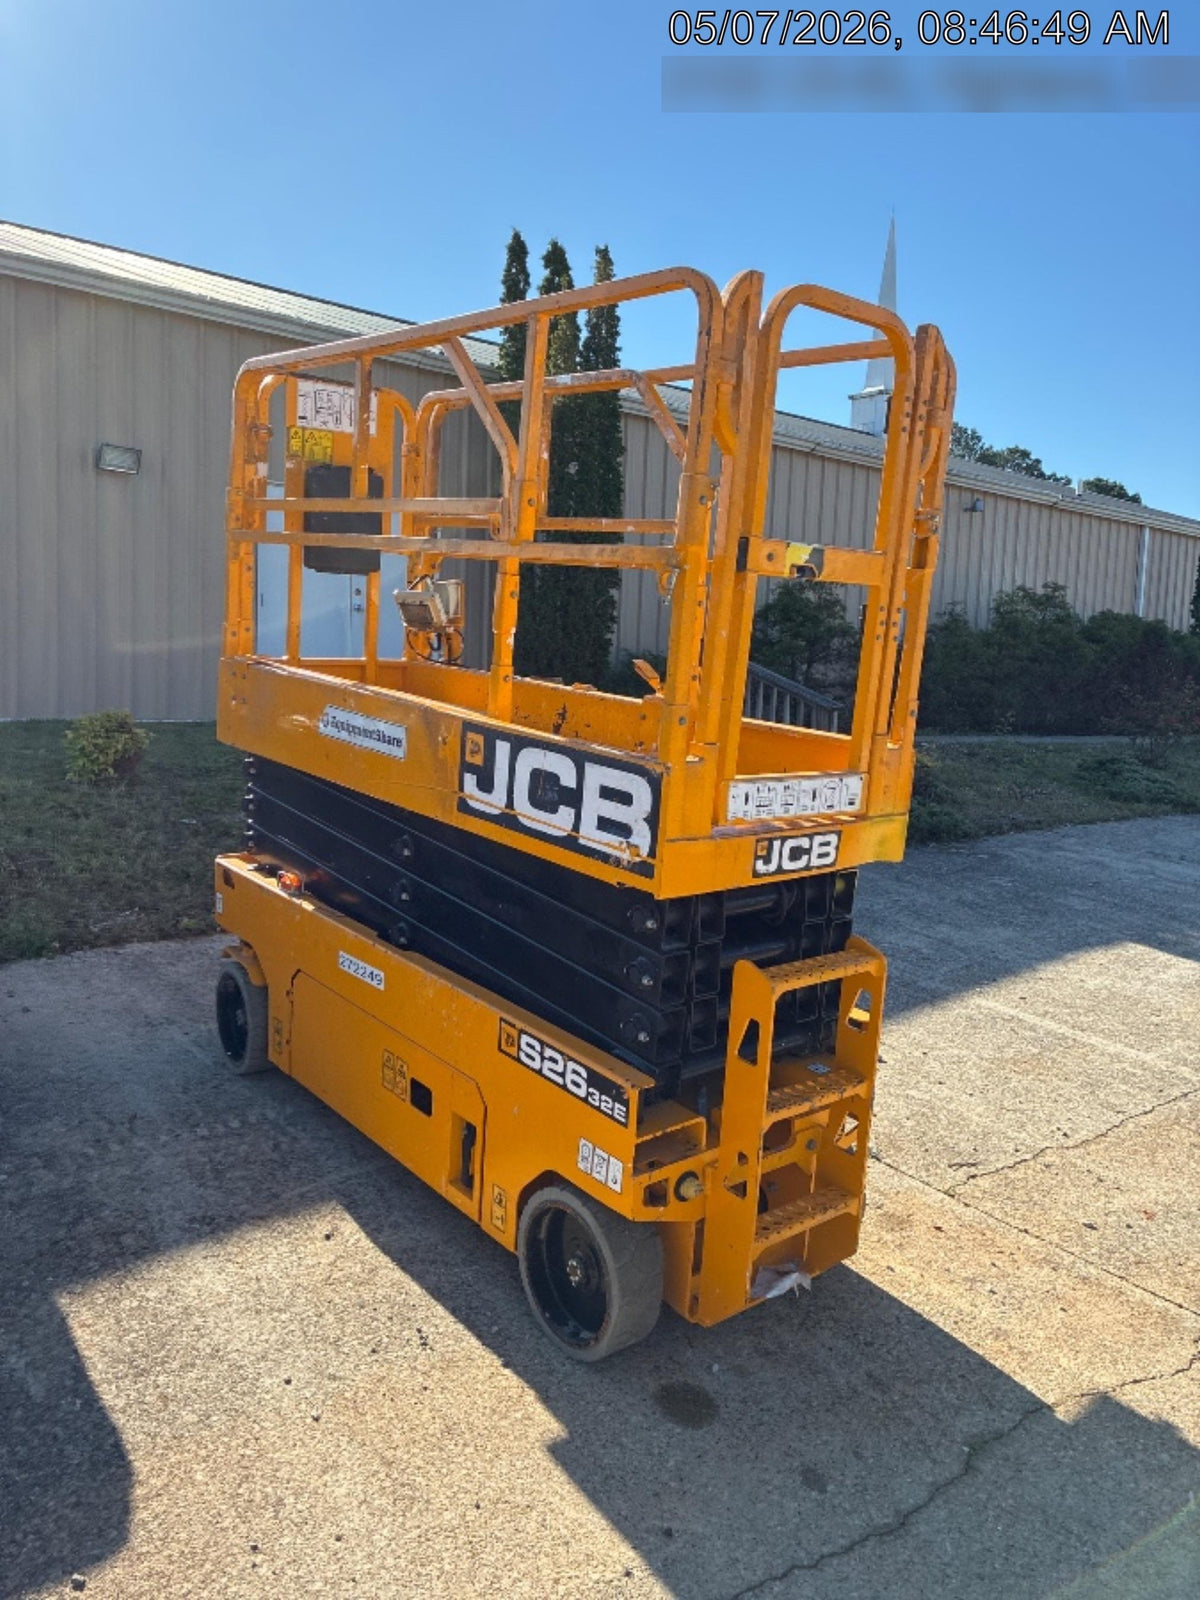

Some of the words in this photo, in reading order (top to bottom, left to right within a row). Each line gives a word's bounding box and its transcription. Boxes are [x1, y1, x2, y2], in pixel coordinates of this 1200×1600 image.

[463, 738, 653, 859] JCB
[755, 833, 839, 874] JCB
[341, 954, 383, 986] 272249
